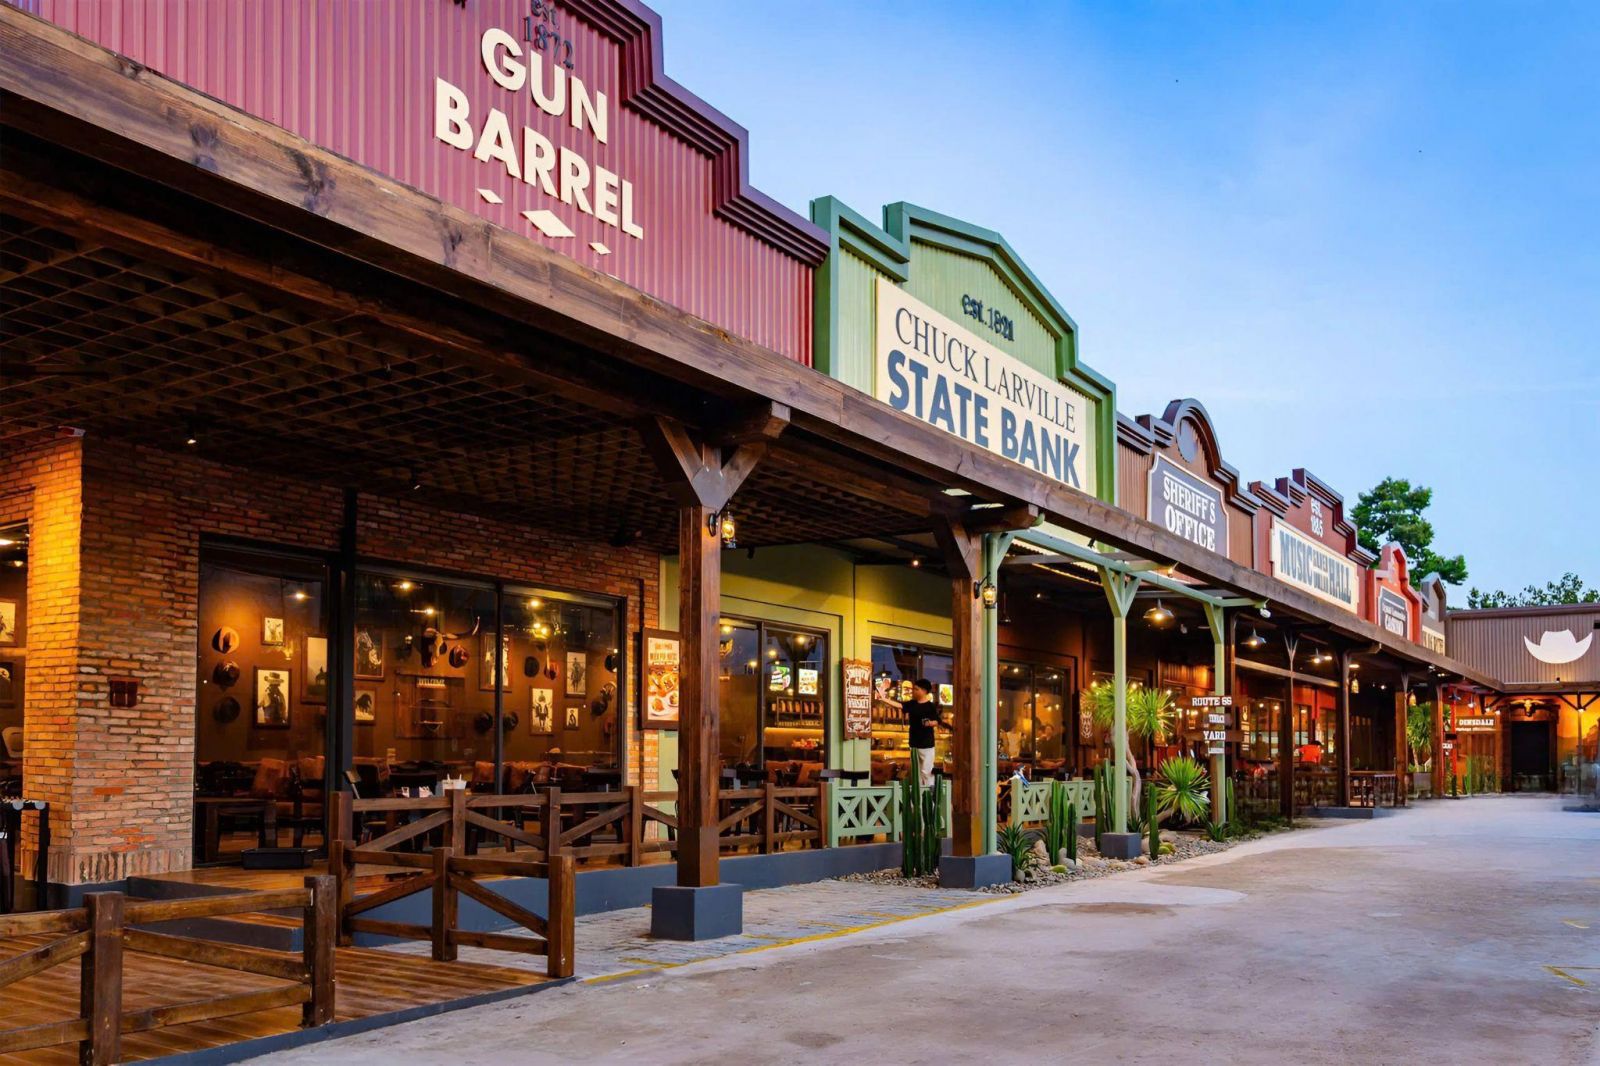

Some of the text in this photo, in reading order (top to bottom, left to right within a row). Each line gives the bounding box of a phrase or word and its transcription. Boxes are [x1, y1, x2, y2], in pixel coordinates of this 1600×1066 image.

[481, 28, 607, 144] GUN
[523, 16, 574, 69] 1872
[436, 77, 643, 240] BARREL
[895, 308, 1076, 433] CHUCK LARVILLE
[887, 349, 1080, 489] STATE BANK
[1165, 504, 1216, 553] OFFICE
[1279, 530, 1313, 586] MUSIC
[1327, 557, 1352, 605] HALL
[1192, 697, 1220, 706] ROUTE
